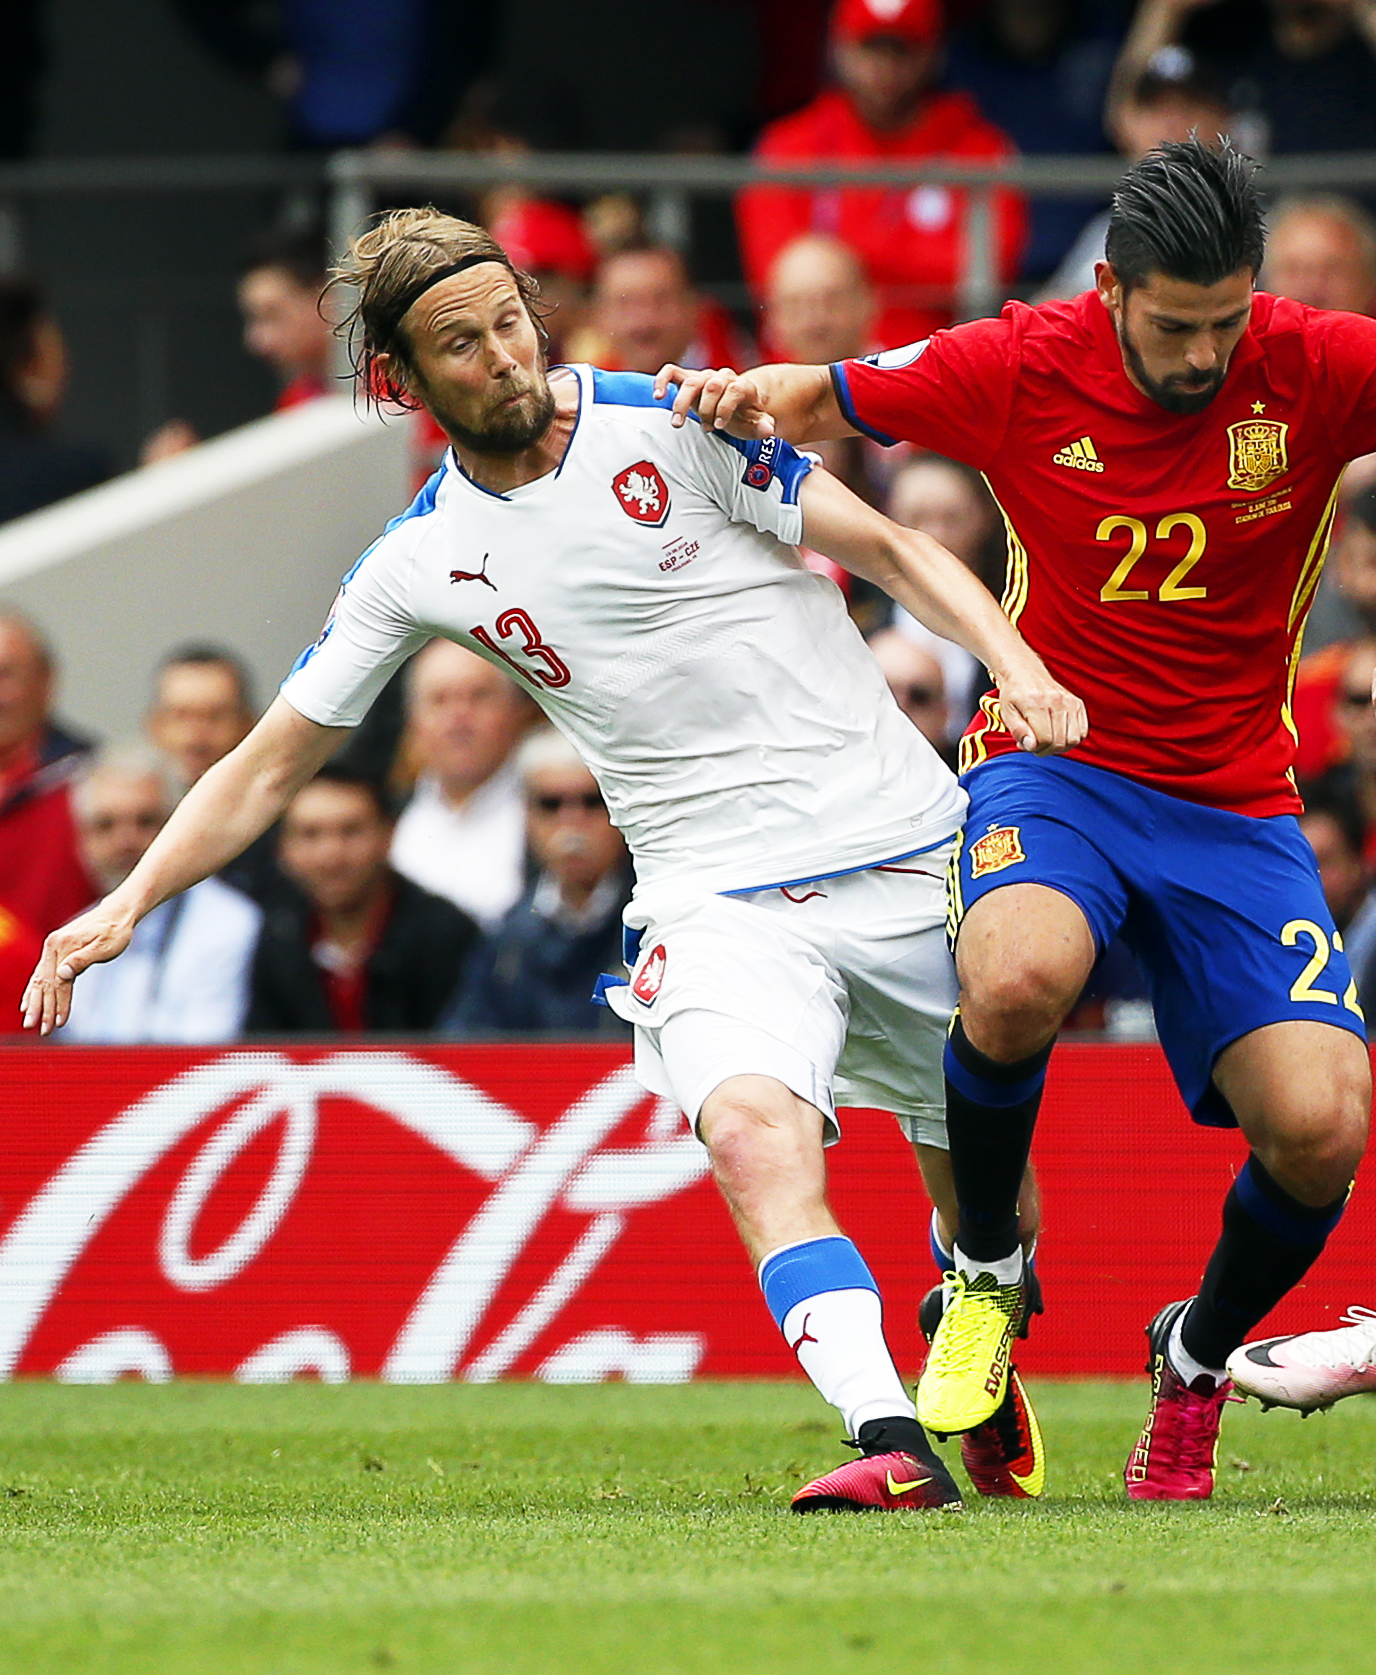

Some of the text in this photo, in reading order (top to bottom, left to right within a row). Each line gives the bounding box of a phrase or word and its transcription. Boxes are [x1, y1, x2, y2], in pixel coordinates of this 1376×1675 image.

[758, 436, 776, 465] RES
[1053, 453, 1104, 473] adidas
[658, 556, 677, 572] ESP
[684, 540, 701, 557] CZE
[1095, 512, 1208, 602] 22
[469, 607, 571, 690] 13
